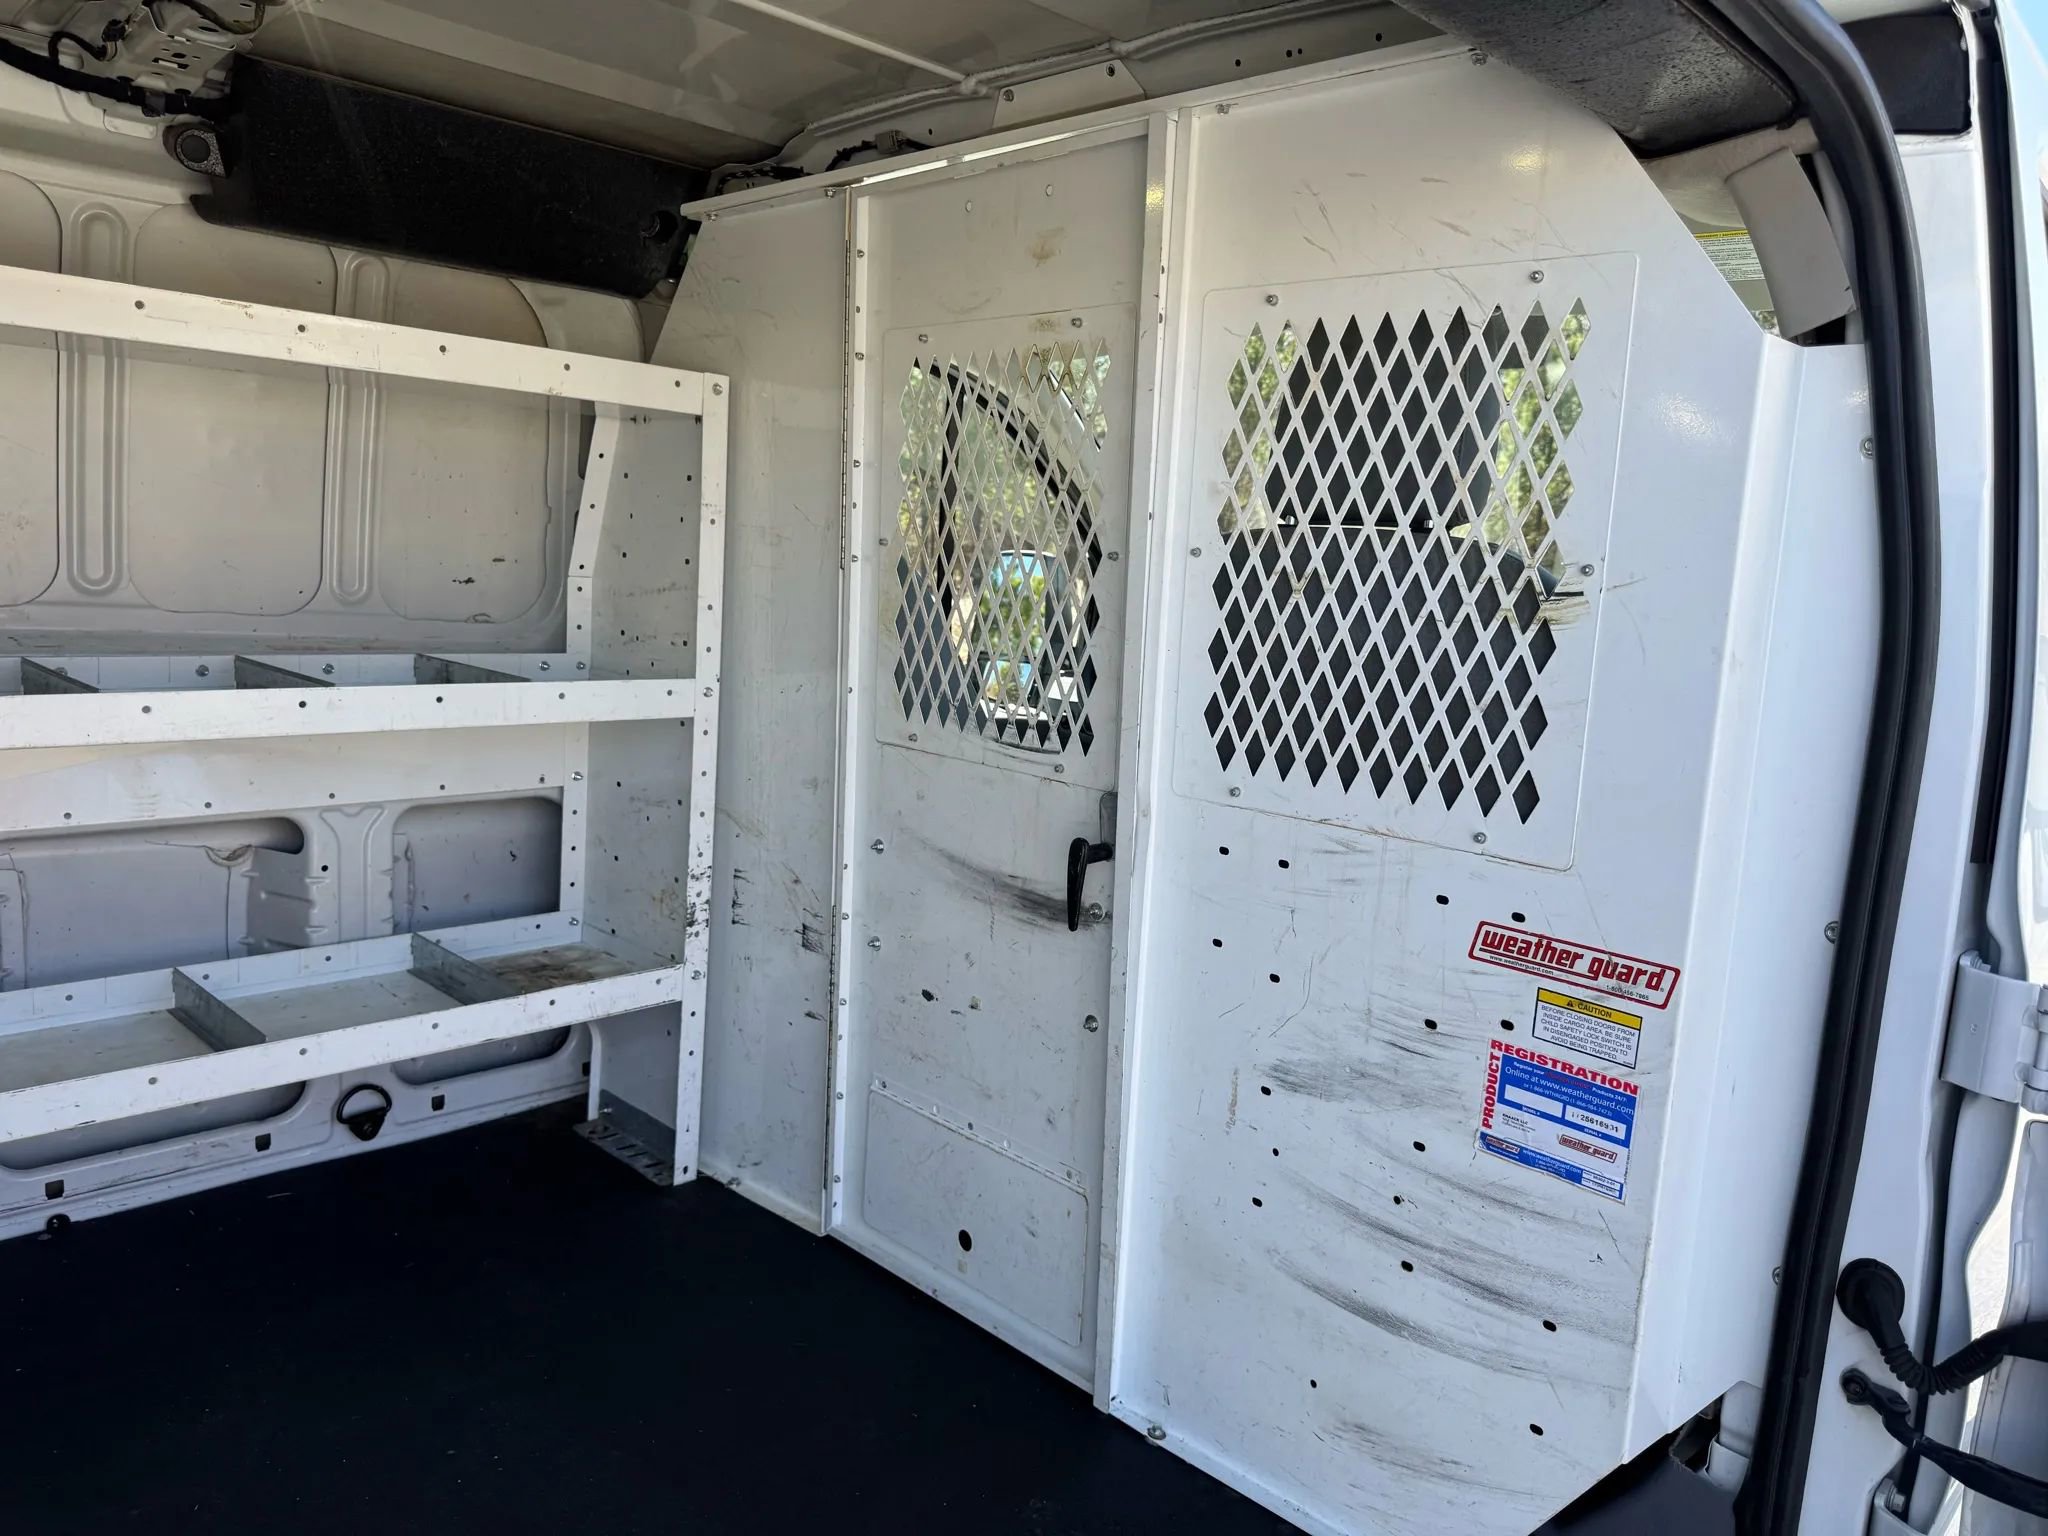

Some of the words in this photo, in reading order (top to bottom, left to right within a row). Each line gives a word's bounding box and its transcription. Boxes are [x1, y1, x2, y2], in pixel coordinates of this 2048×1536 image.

[1481, 929, 1585, 970] weather
[1588, 954, 1666, 992] guard
[1488, 955, 1555, 976] www.weatherguard.com
[1541, 1005, 1565, 1016] BEFORE
[1566, 1012, 1593, 1025] CLOSING
[1594, 1021, 1616, 1031] DOORS
[1617, 1027, 1635, 1037] FROM
[1578, 1003, 1612, 1018] CAUTION
[1541, 1018, 1558, 1028] CHILD
[1559, 1024, 1582, 1035] SAFETY
[1584, 1031, 1599, 1040] LOCK
[1600, 1037, 1624, 1048] SWITCH
[1543, 1012, 1562, 1022] INSIDE
[1564, 1018, 1585, 1029] CARGO
[1615, 1034, 1631, 1043] SURE
[1550, 1028, 1588, 1044] DISENGAGED
[1589, 1040, 1618, 1053] POSITION
[1550, 1034, 1568, 1044] AVOID
[1569, 1040, 1588, 1050] BEING
[1589, 1047, 1618, 1060] TRAPPED.
[1490, 1040, 1639, 1095] REGISTRATION
[1513, 1061, 1532, 1071] Register
[1592, 1087, 1614, 1098] Products
[1482, 1052, 1500, 1129] PRODUCT
[1505, 1066, 1530, 1081] Online
[1530, 1075, 1539, 1084] at
[1539, 1078, 1634, 1116] www.weatherguard.com
[1561, 1135, 1590, 1152] weather
[1592, 1146, 1614, 1162] guard
